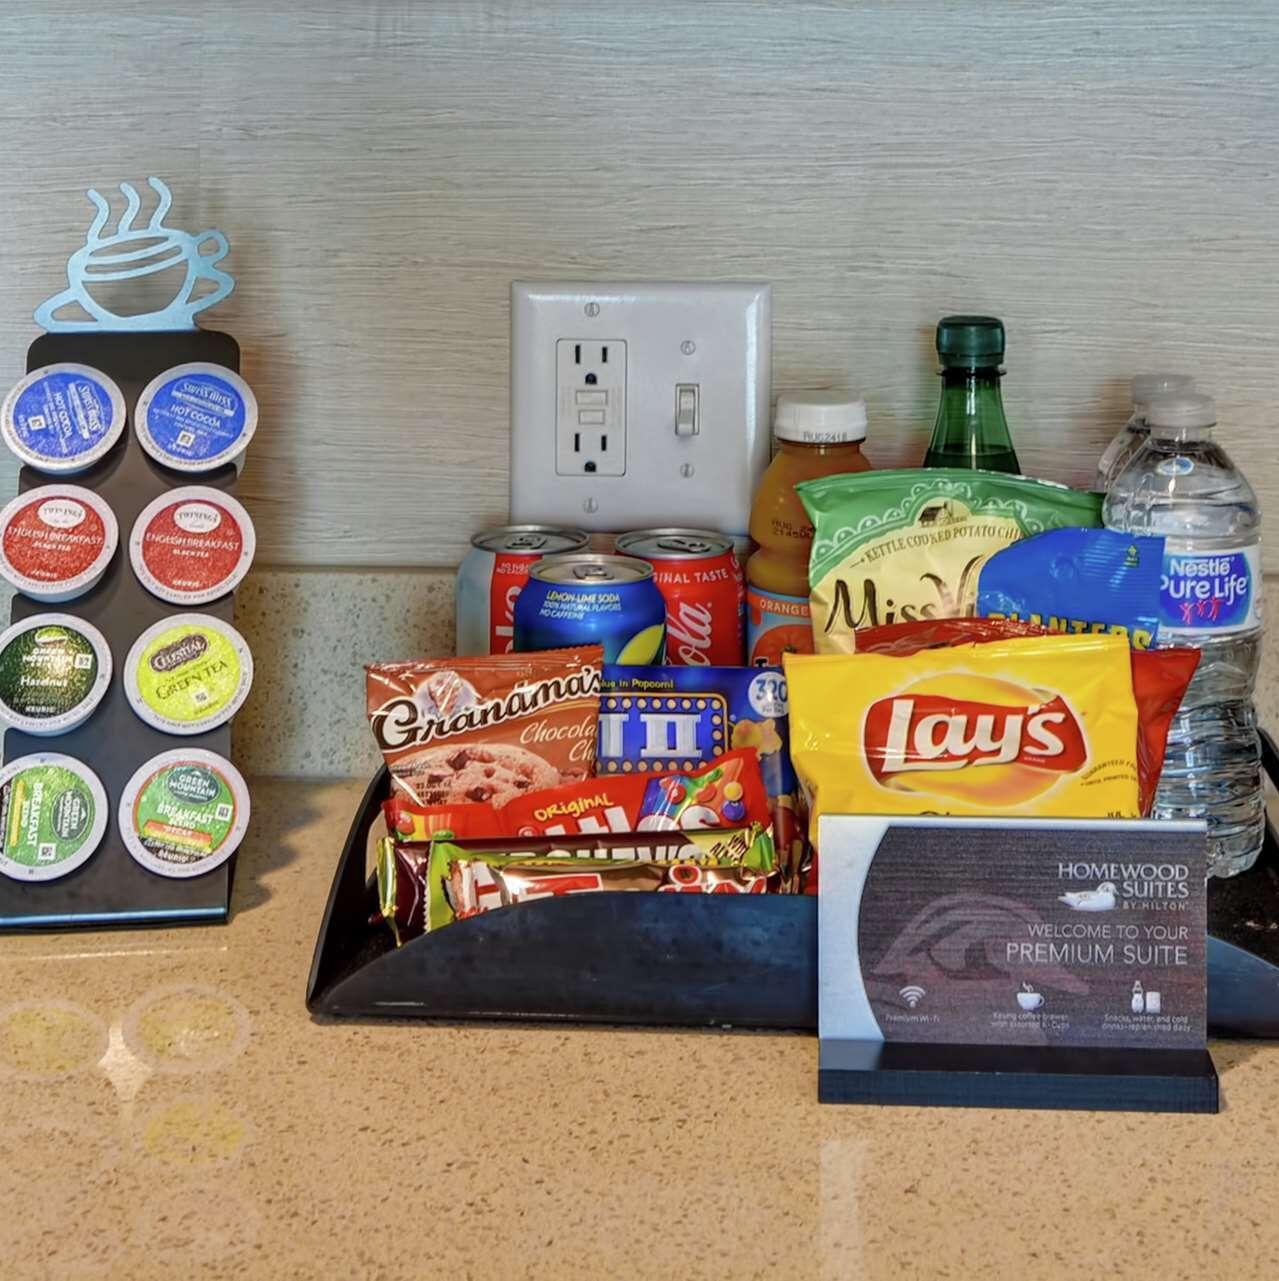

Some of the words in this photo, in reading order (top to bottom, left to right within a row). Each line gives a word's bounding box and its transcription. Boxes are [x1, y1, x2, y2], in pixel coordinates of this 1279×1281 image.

[171, 405, 190, 416] HOT
[190, 411, 220, 427] COCOA
[185, 538, 240, 551] BREAKFAST
[866, 535, 907, 562] KETTLE
[953, 525, 995, 539] POTATO
[694, 568, 728, 582] TASTE
[546, 590, 596, 603] LEMON-LIME
[598, 592, 620, 603] SODA
[1214, 574, 1248, 606] Life
[539, 608, 551, 616] NO
[760, 599, 808, 615] ORANGE
[825, 579, 937, 633] Miss
[631, 678, 674, 690] Popcorn!
[881, 699, 1066, 773] Lay's
[169, 781, 216, 797] MOUNTAIN
[179, 775, 210, 787] GREEN
[157, 803, 213, 824] BREAKFAST
[1058, 862, 1189, 881] HOMEWOOD
[1122, 881, 1189, 899] SUITES
[1123, 901, 1138, 910] BY
[1142, 901, 1186, 911] HILTON
[1028, 923, 1111, 939] WELCOME
[1116, 925, 1139, 939] TO
[1143, 926, 1189, 940] YOUR
[1006, 942, 1114, 964] PREMIUM
[1123, 944, 1188, 965] SUITE
